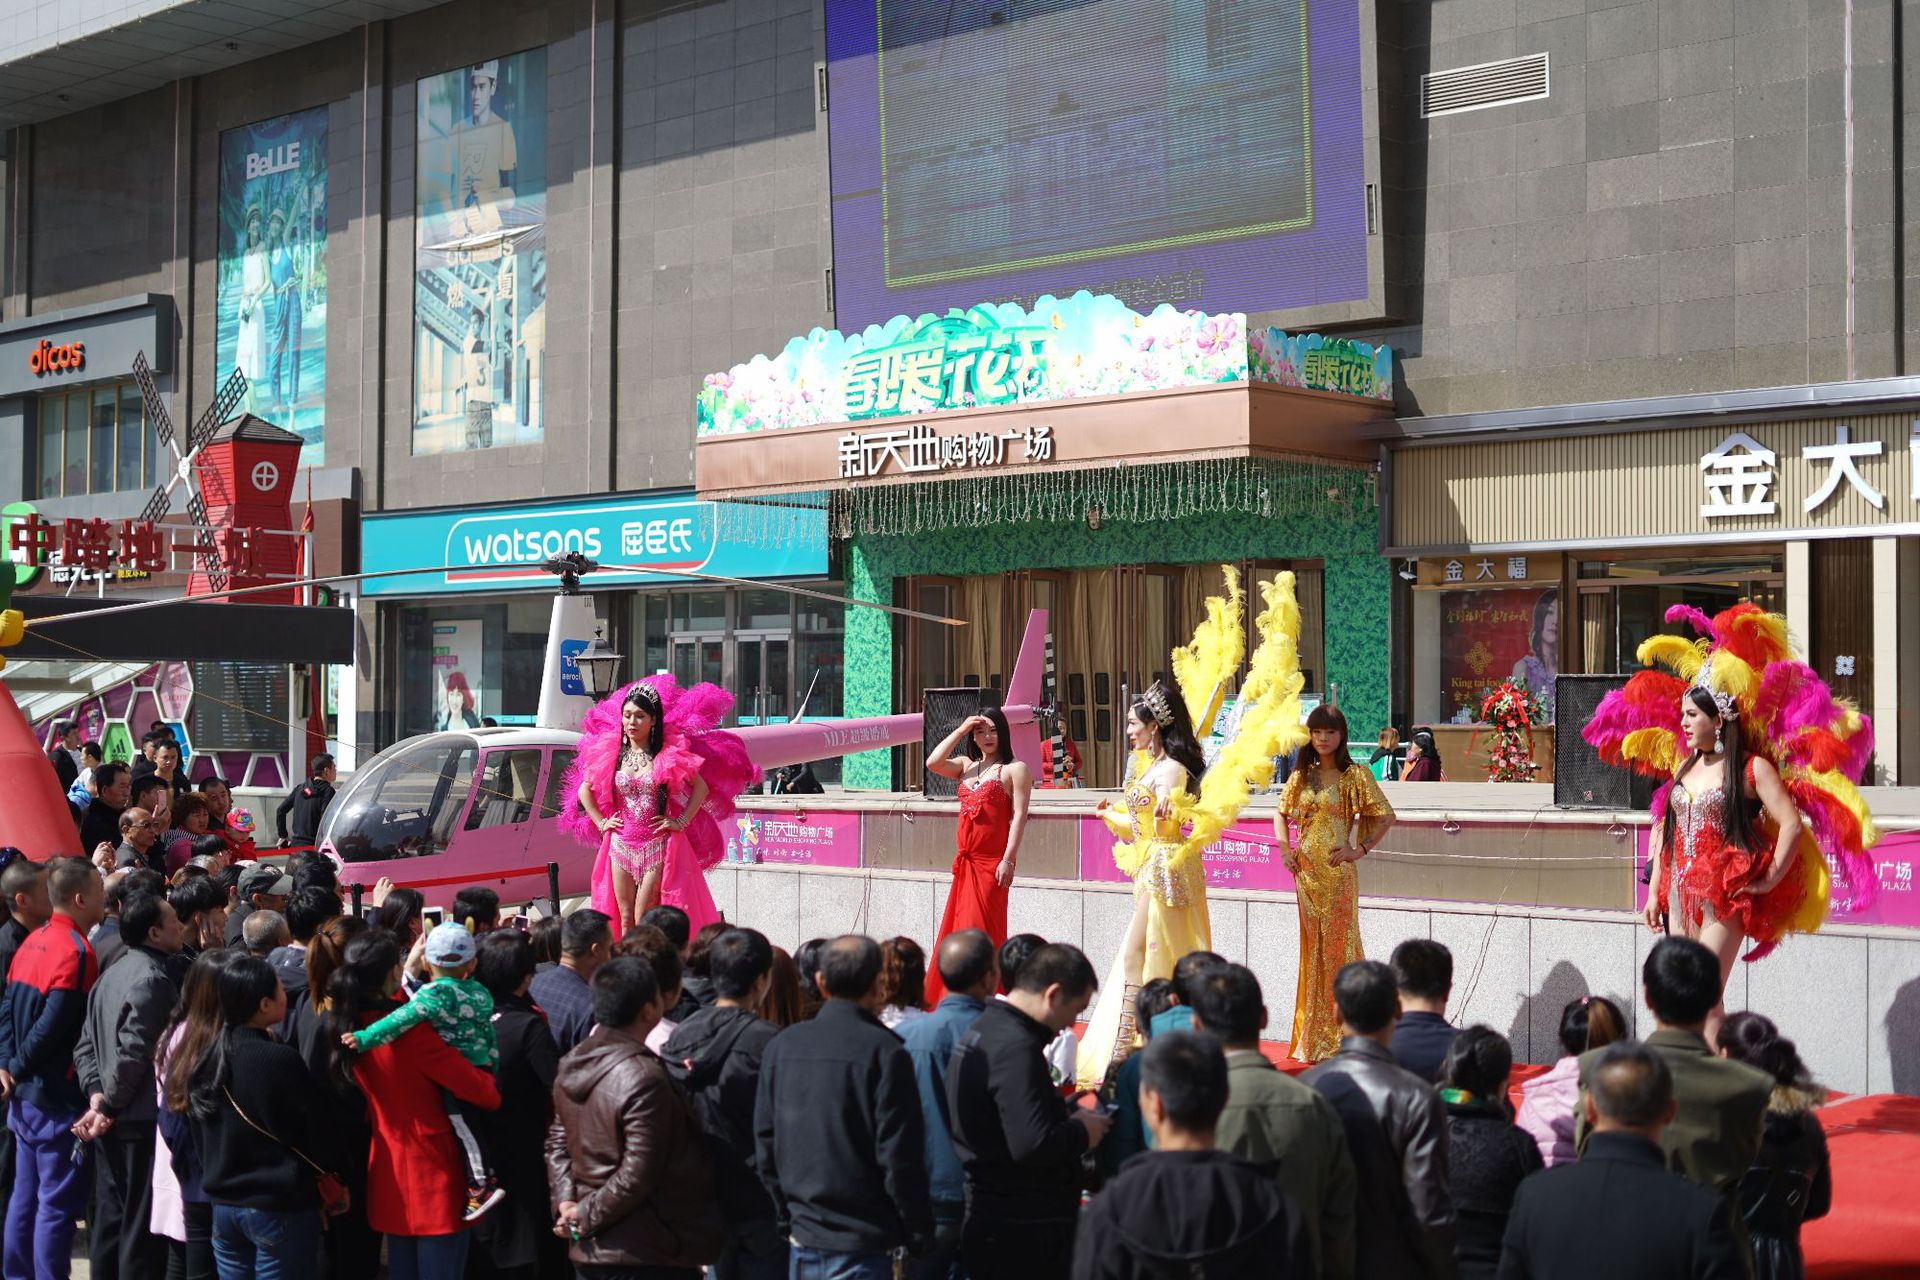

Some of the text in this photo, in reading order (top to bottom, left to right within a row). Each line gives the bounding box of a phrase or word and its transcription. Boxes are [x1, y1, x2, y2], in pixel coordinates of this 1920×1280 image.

[28, 339, 83, 375] dicos
[841, 329, 1053, 413] 春暖花开
[1700, 420, 1920, 517] 金大
[464, 527, 602, 565] watsons
[621, 518, 692, 556] 屈臣氏
[1445, 556, 1527, 581] 金大福
[1216, 854, 1248, 862] SHOPPING
[1249, 856, 1270, 864] PLAZA
[1881, 881, 1912, 891] PLAZA
